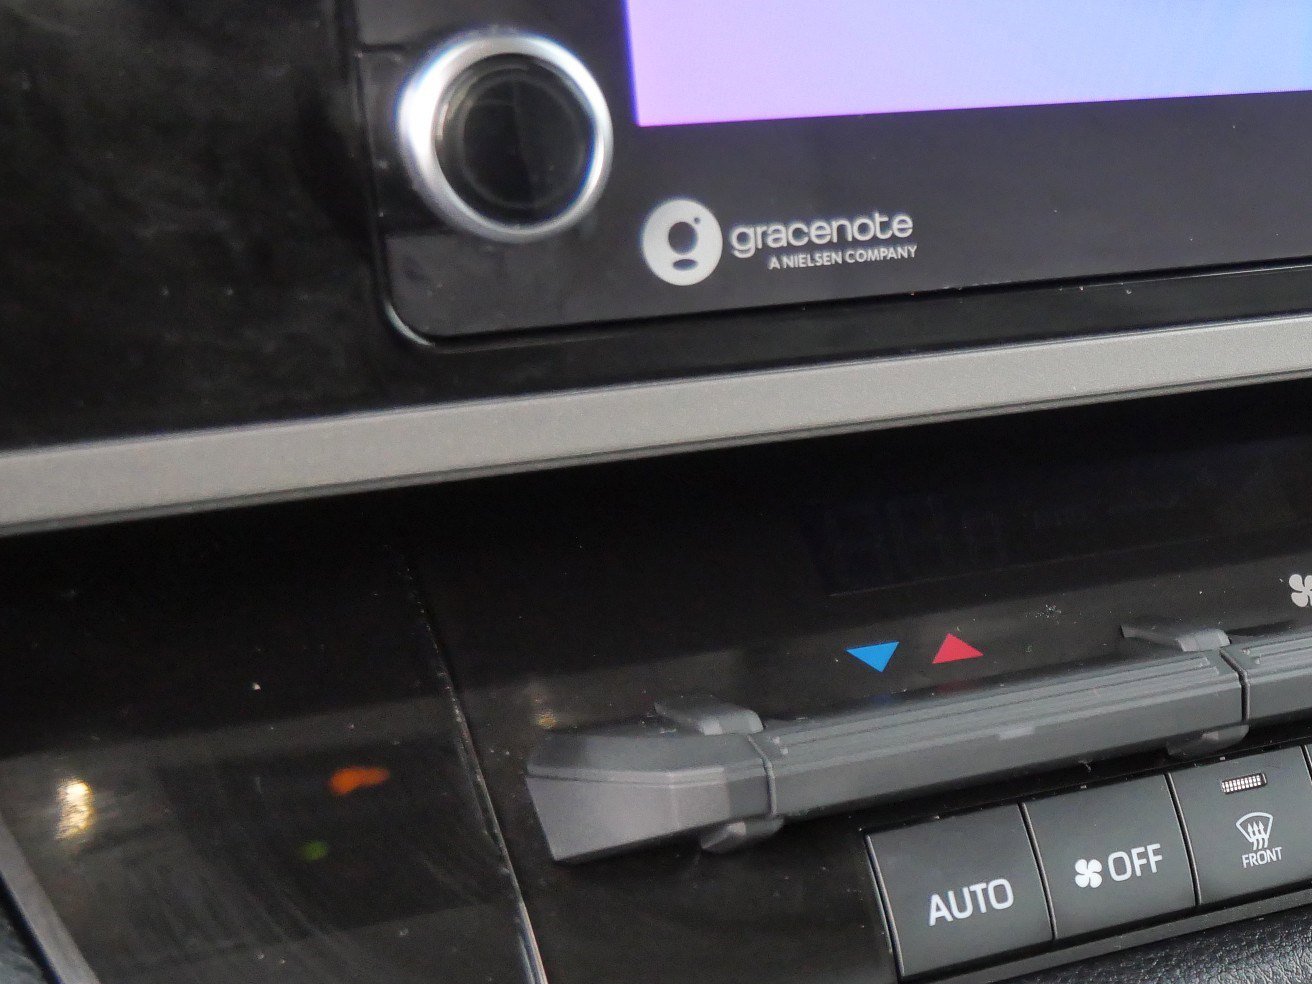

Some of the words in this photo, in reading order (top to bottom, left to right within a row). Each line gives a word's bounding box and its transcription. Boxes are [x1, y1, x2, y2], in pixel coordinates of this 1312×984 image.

[730, 210, 914, 258] gracenote
[768, 256, 781, 270] A
[783, 251, 842, 269] NIELSEN
[845, 244, 918, 264] COMPANY
[1107, 843, 1162, 882] OFF
[1241, 847, 1283, 869] FRONT
[928, 878, 1014, 926] AUTO
